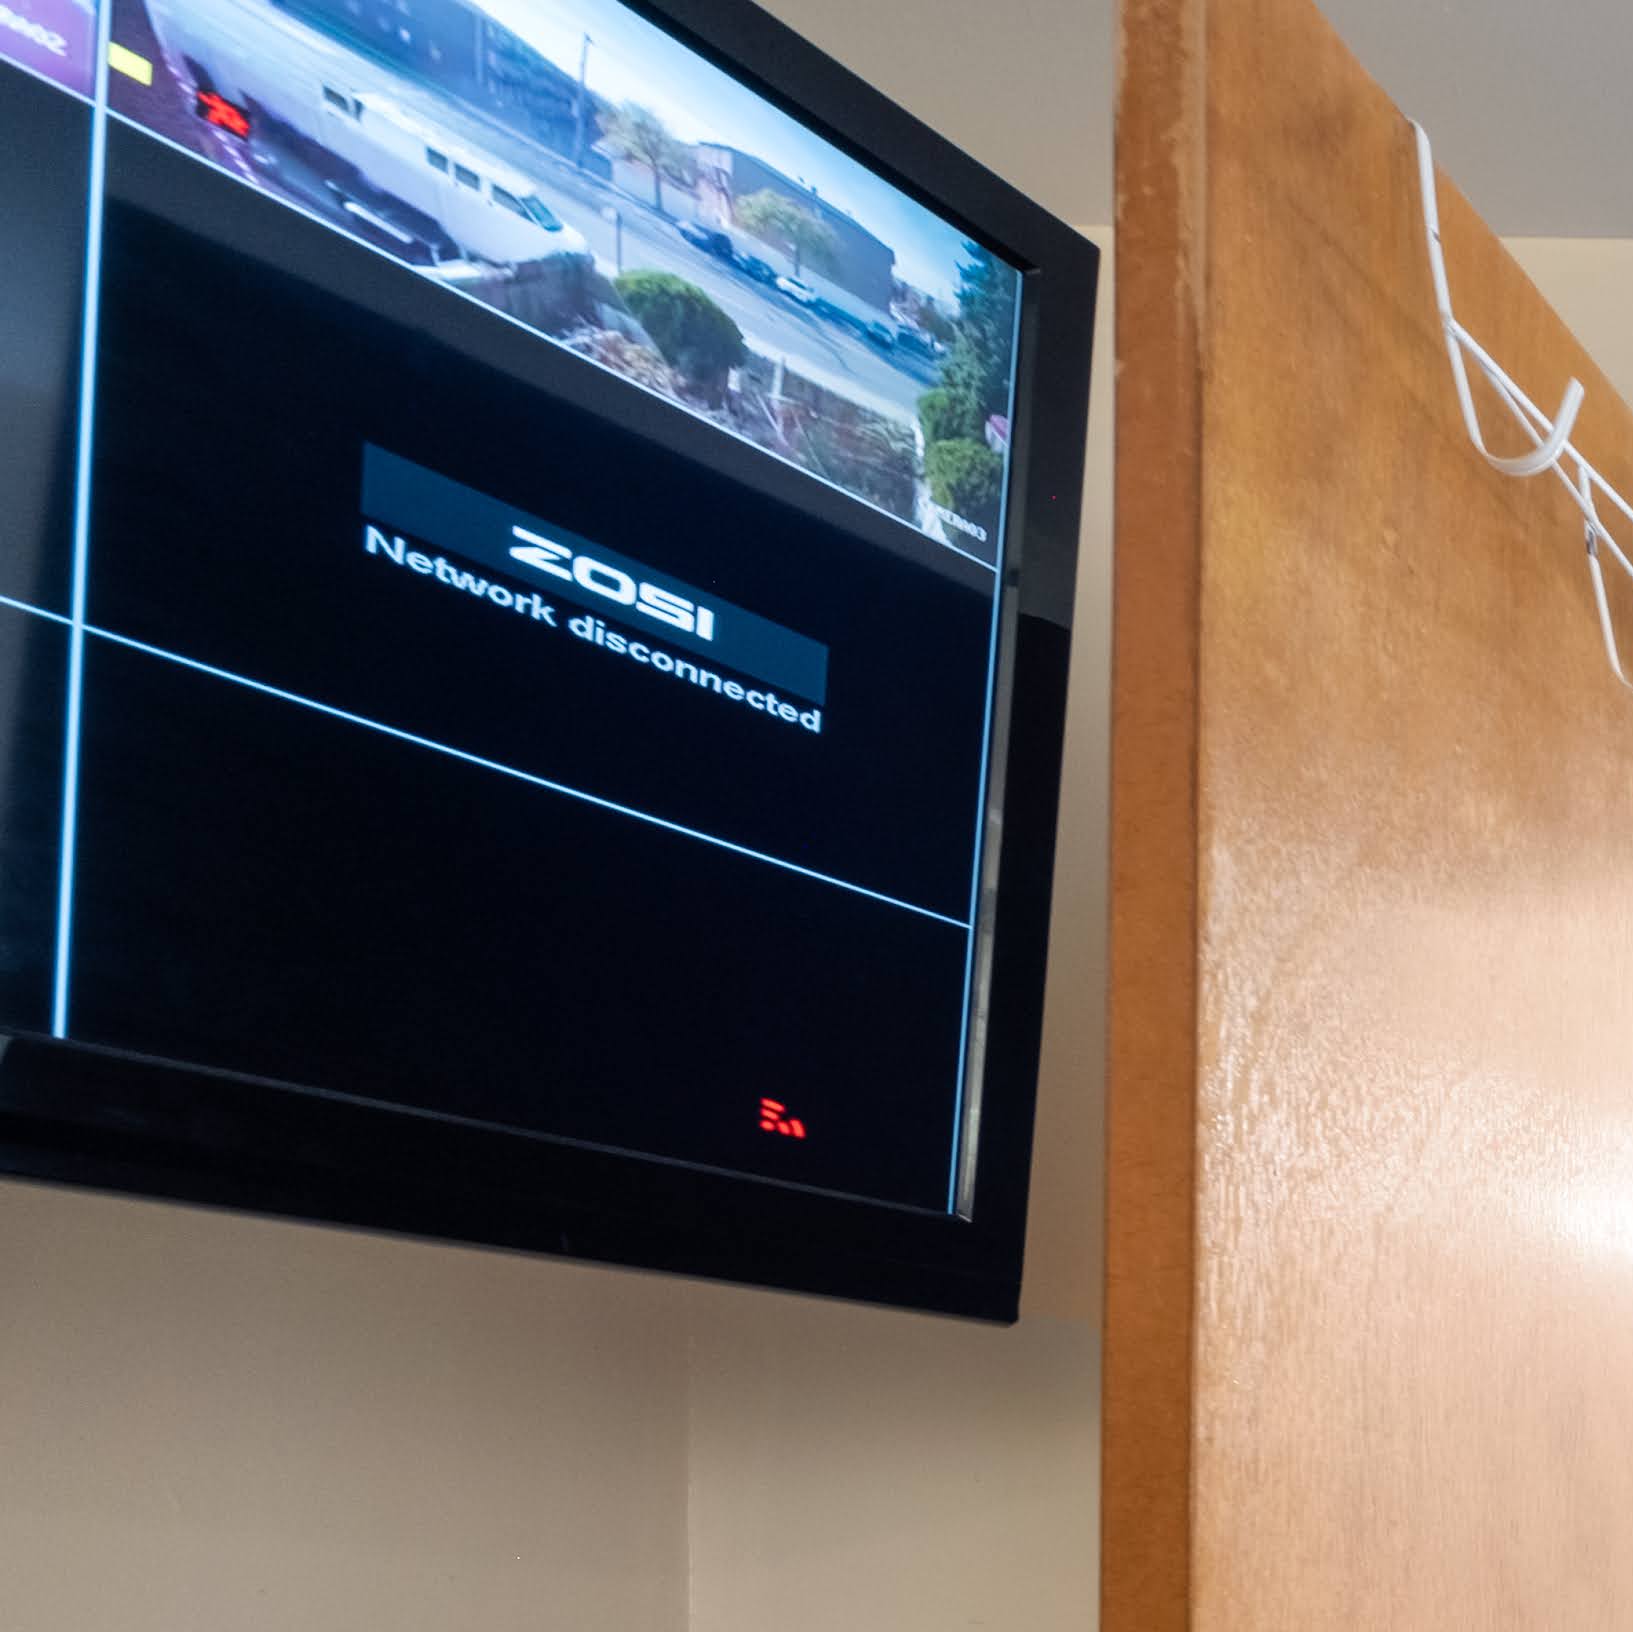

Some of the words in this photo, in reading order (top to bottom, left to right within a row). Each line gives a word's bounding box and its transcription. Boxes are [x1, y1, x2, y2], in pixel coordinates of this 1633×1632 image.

[364, 524, 558, 628] Network
[567, 613, 823, 734] disconnected
[508, 524, 716, 642] ZOSI
